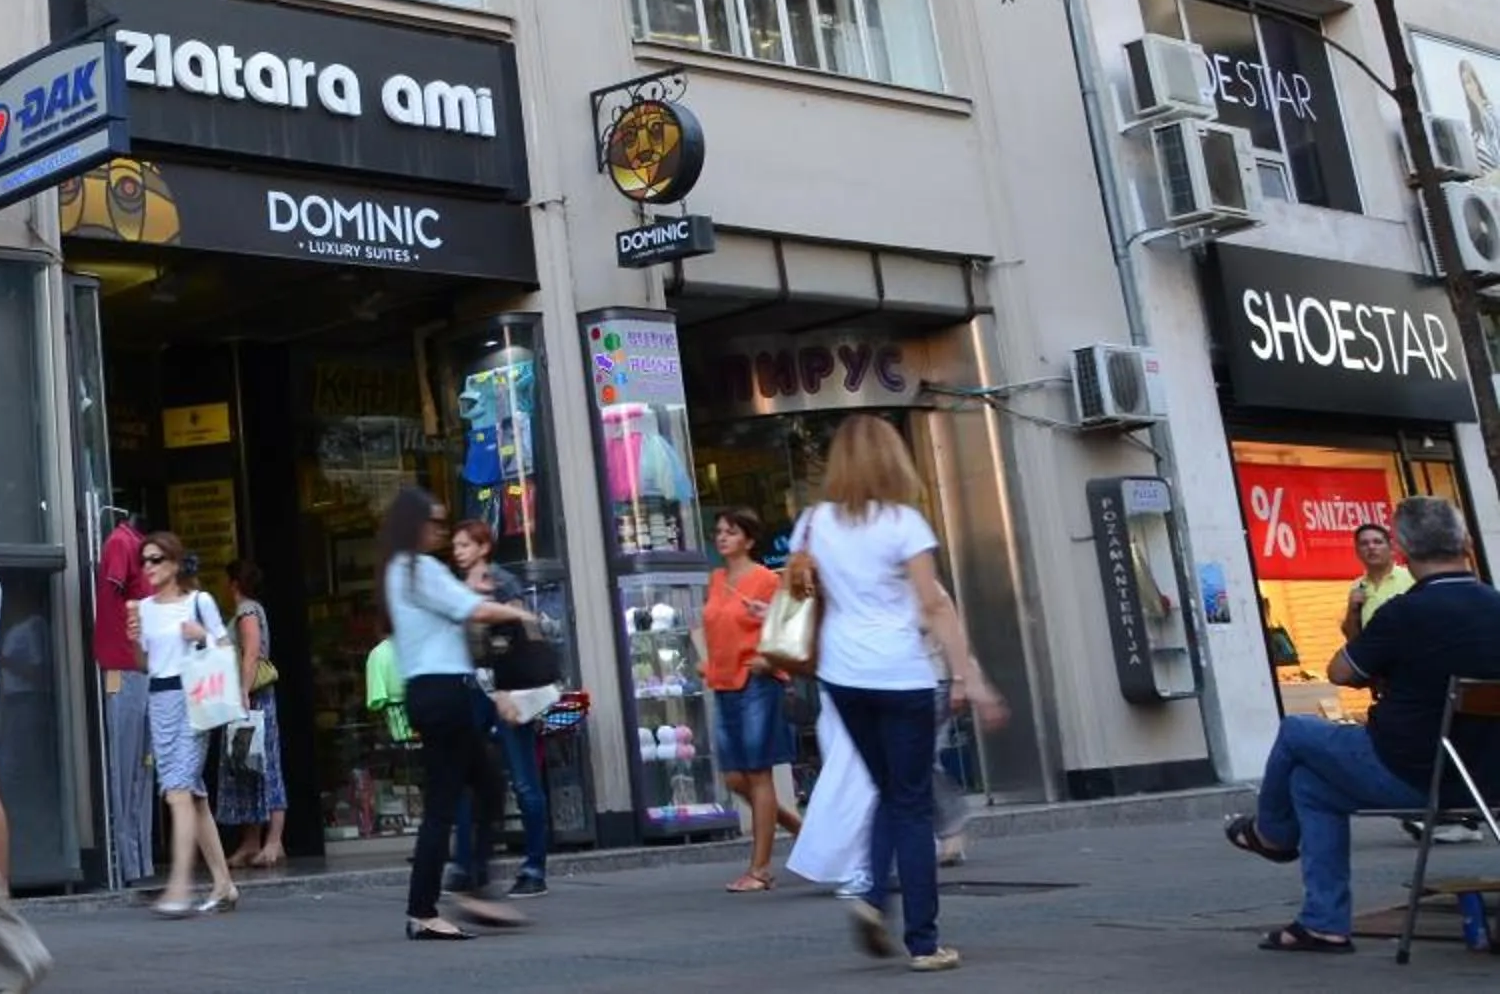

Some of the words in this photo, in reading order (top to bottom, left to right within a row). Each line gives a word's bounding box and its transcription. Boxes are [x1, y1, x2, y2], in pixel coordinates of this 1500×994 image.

[115, 29, 362, 117] zlatara
[381, 73, 497, 137] ami
[267, 190, 443, 249] DOMINIC
[308, 240, 361, 257] LUXURY
[365, 246, 411, 263] SUITES
[620, 221, 689, 253] DOMINIC
[1243, 288, 1457, 382] SHOESTAR
[1102, 497, 1142, 666] POZAMANTERIJA
